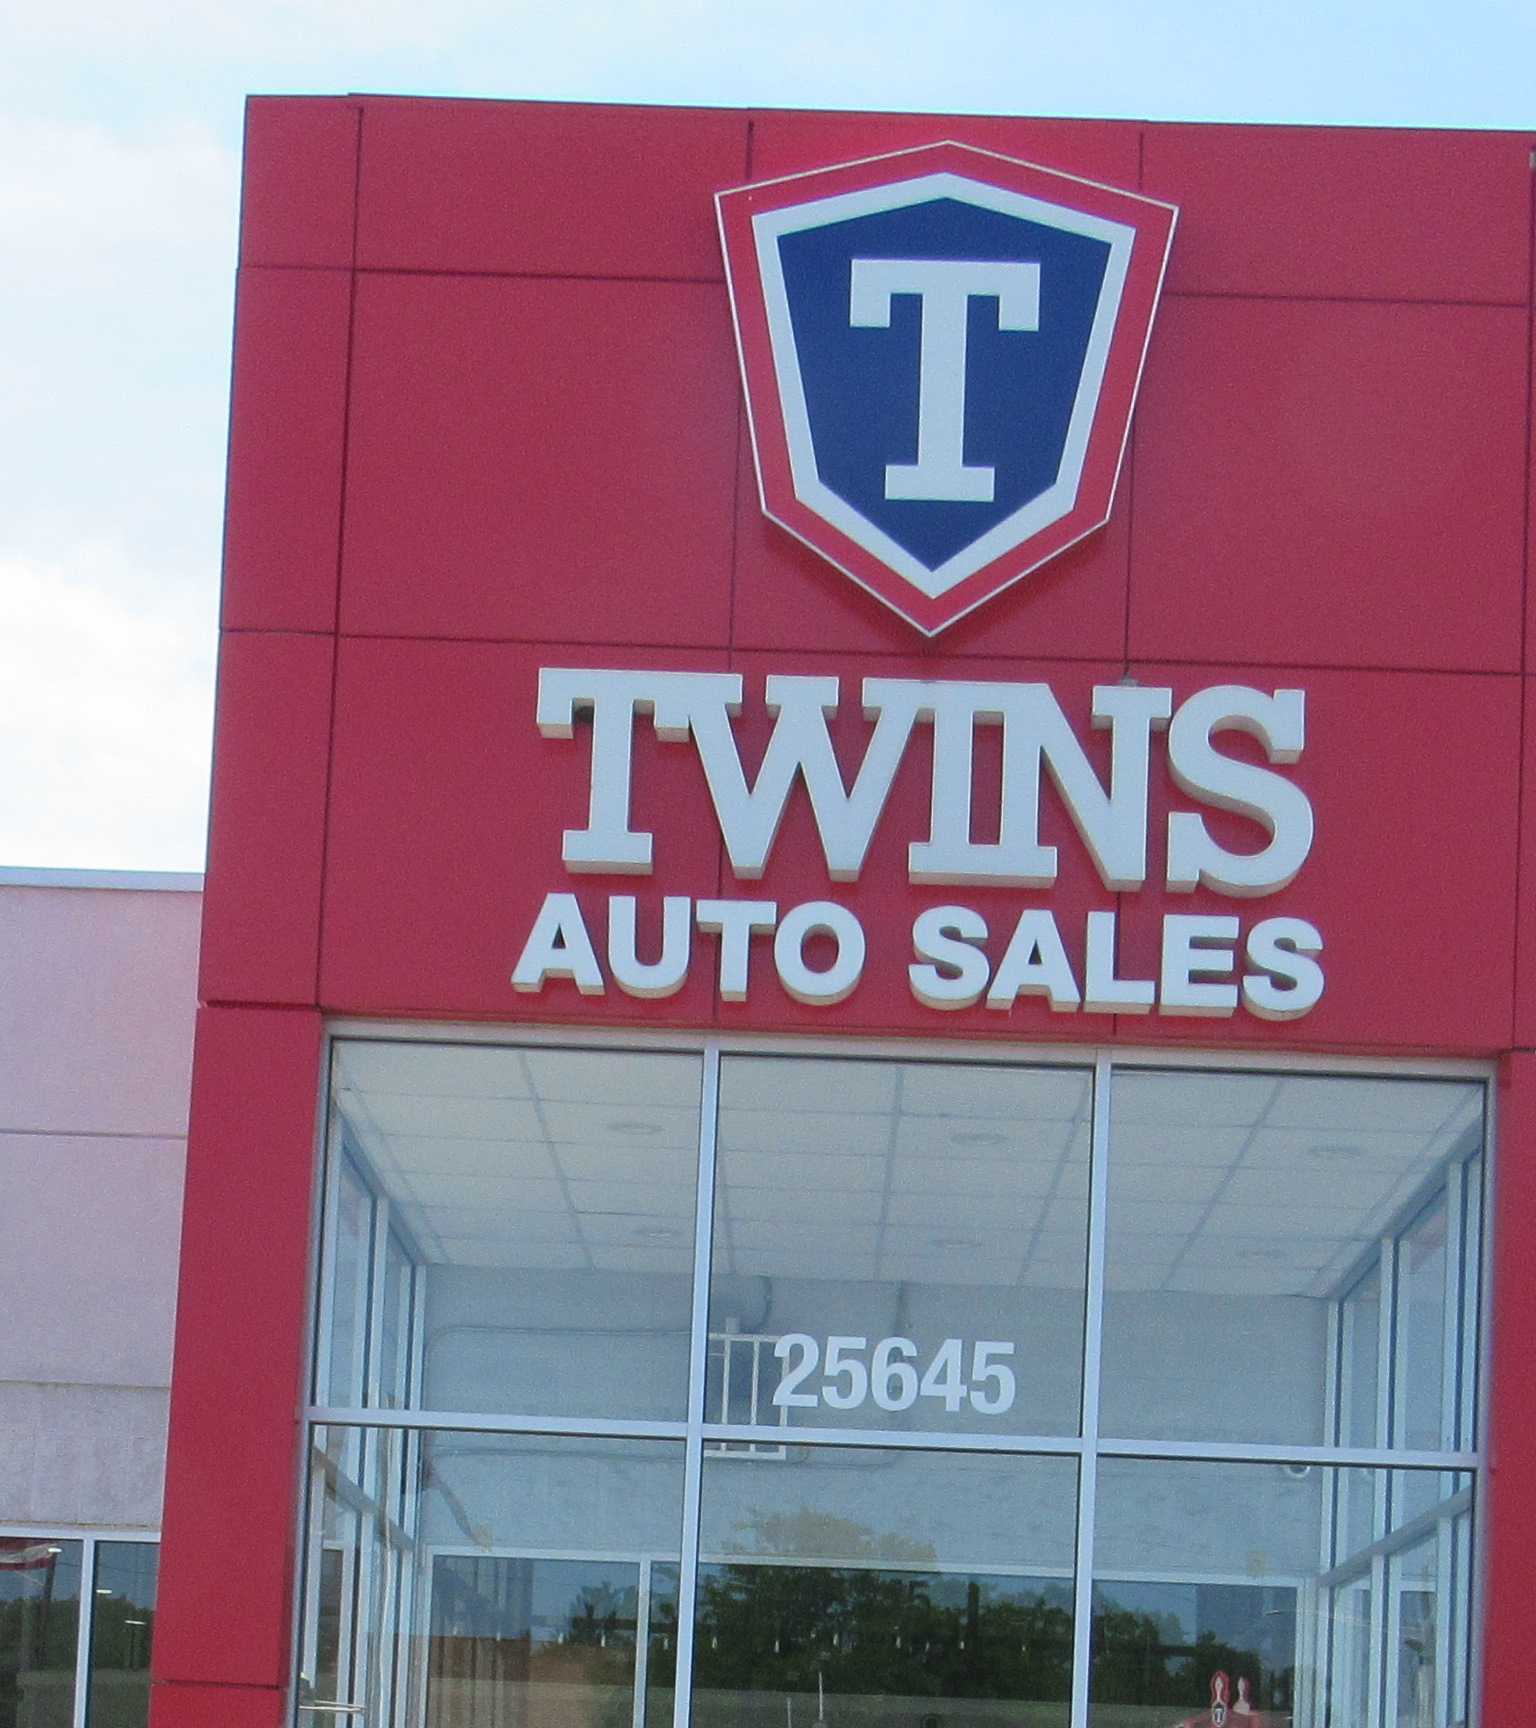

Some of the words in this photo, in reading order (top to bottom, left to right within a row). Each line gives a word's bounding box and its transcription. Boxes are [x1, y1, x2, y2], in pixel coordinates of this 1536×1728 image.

[849, 257, 1041, 503] T
[536, 667, 1316, 898] TWINS
[510, 892, 866, 1006] AUTO
[907, 904, 1326, 1021] SALES
[771, 1332, 1016, 1416] 25645
